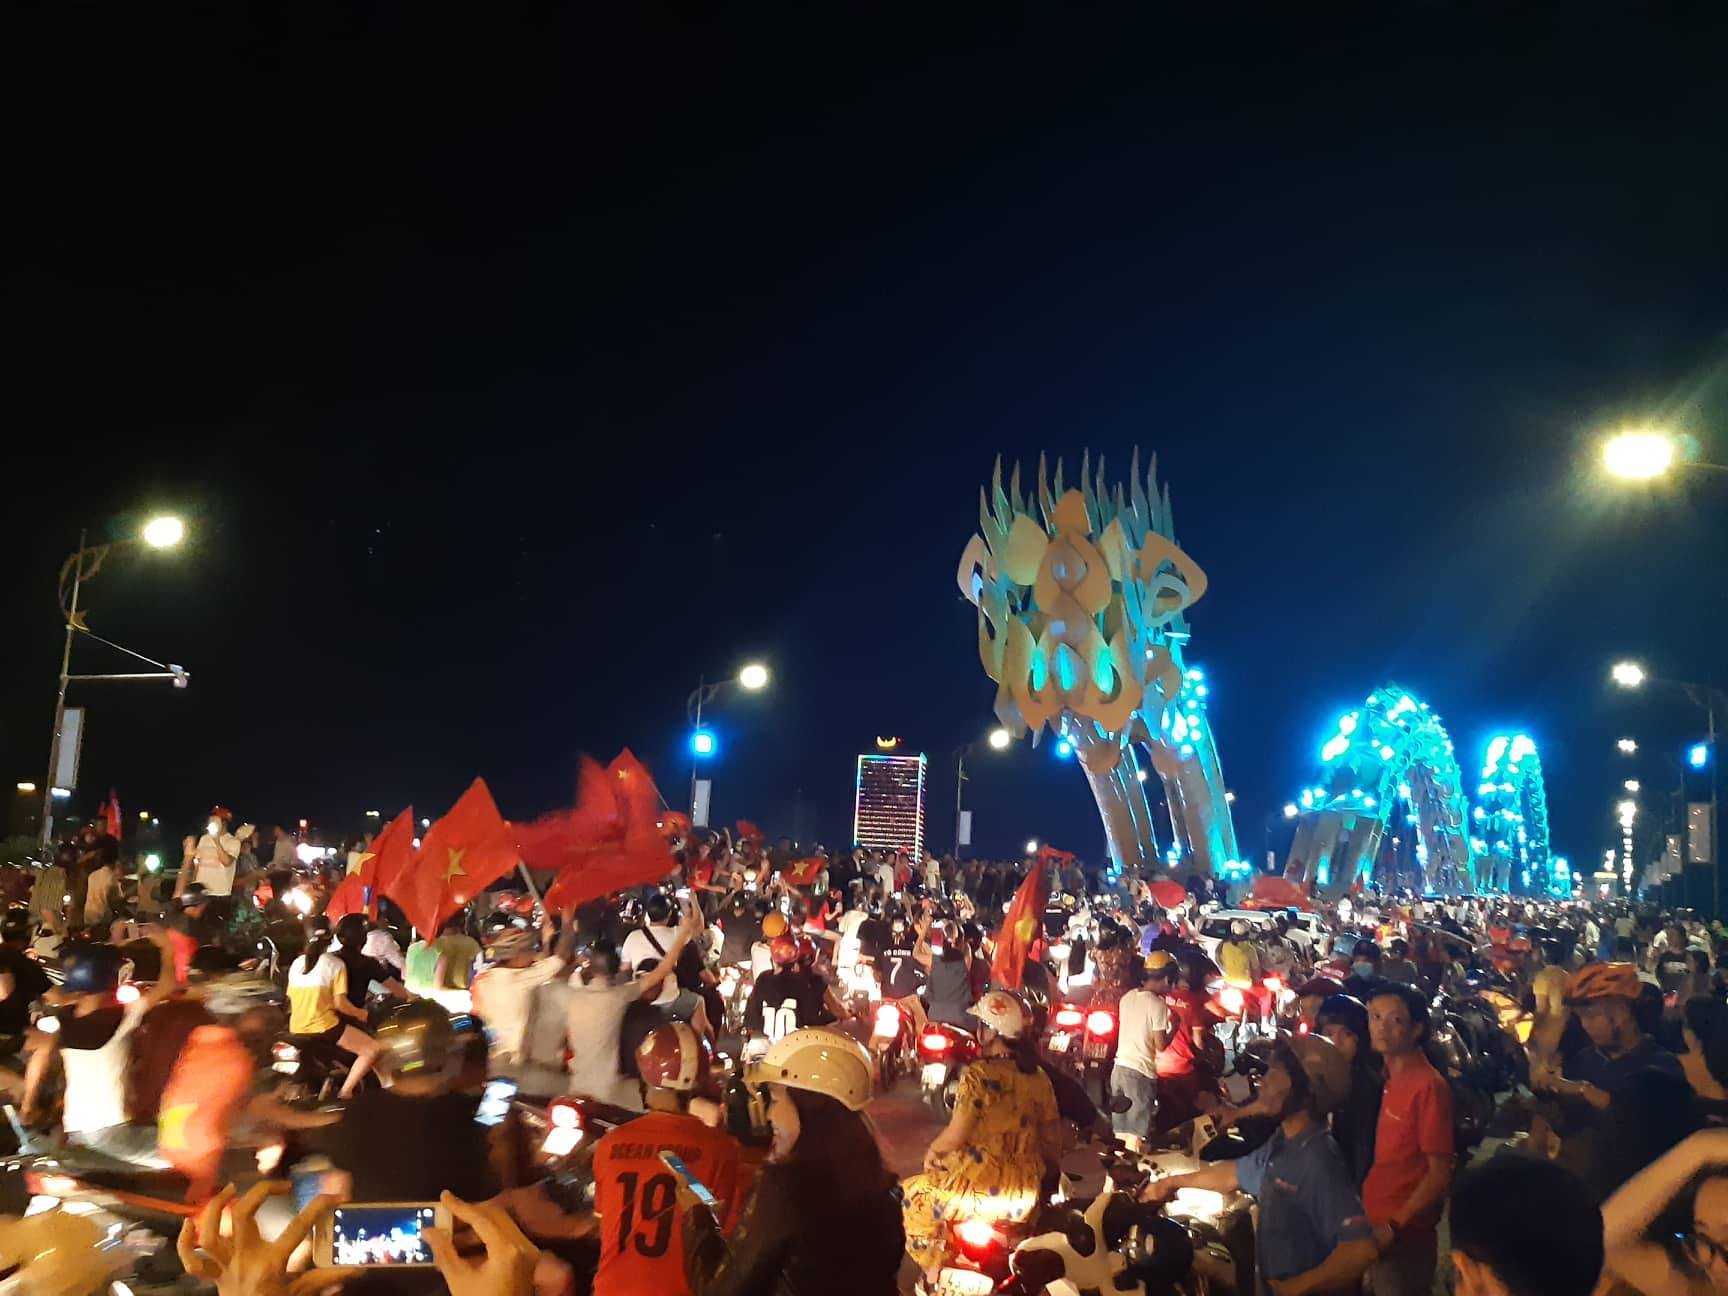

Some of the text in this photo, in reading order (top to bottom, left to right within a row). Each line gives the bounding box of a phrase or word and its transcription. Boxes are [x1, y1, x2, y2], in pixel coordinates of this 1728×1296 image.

[890, 957, 902, 985] 7
[762, 998, 797, 1041] 10
[616, 1171, 677, 1258] 19
